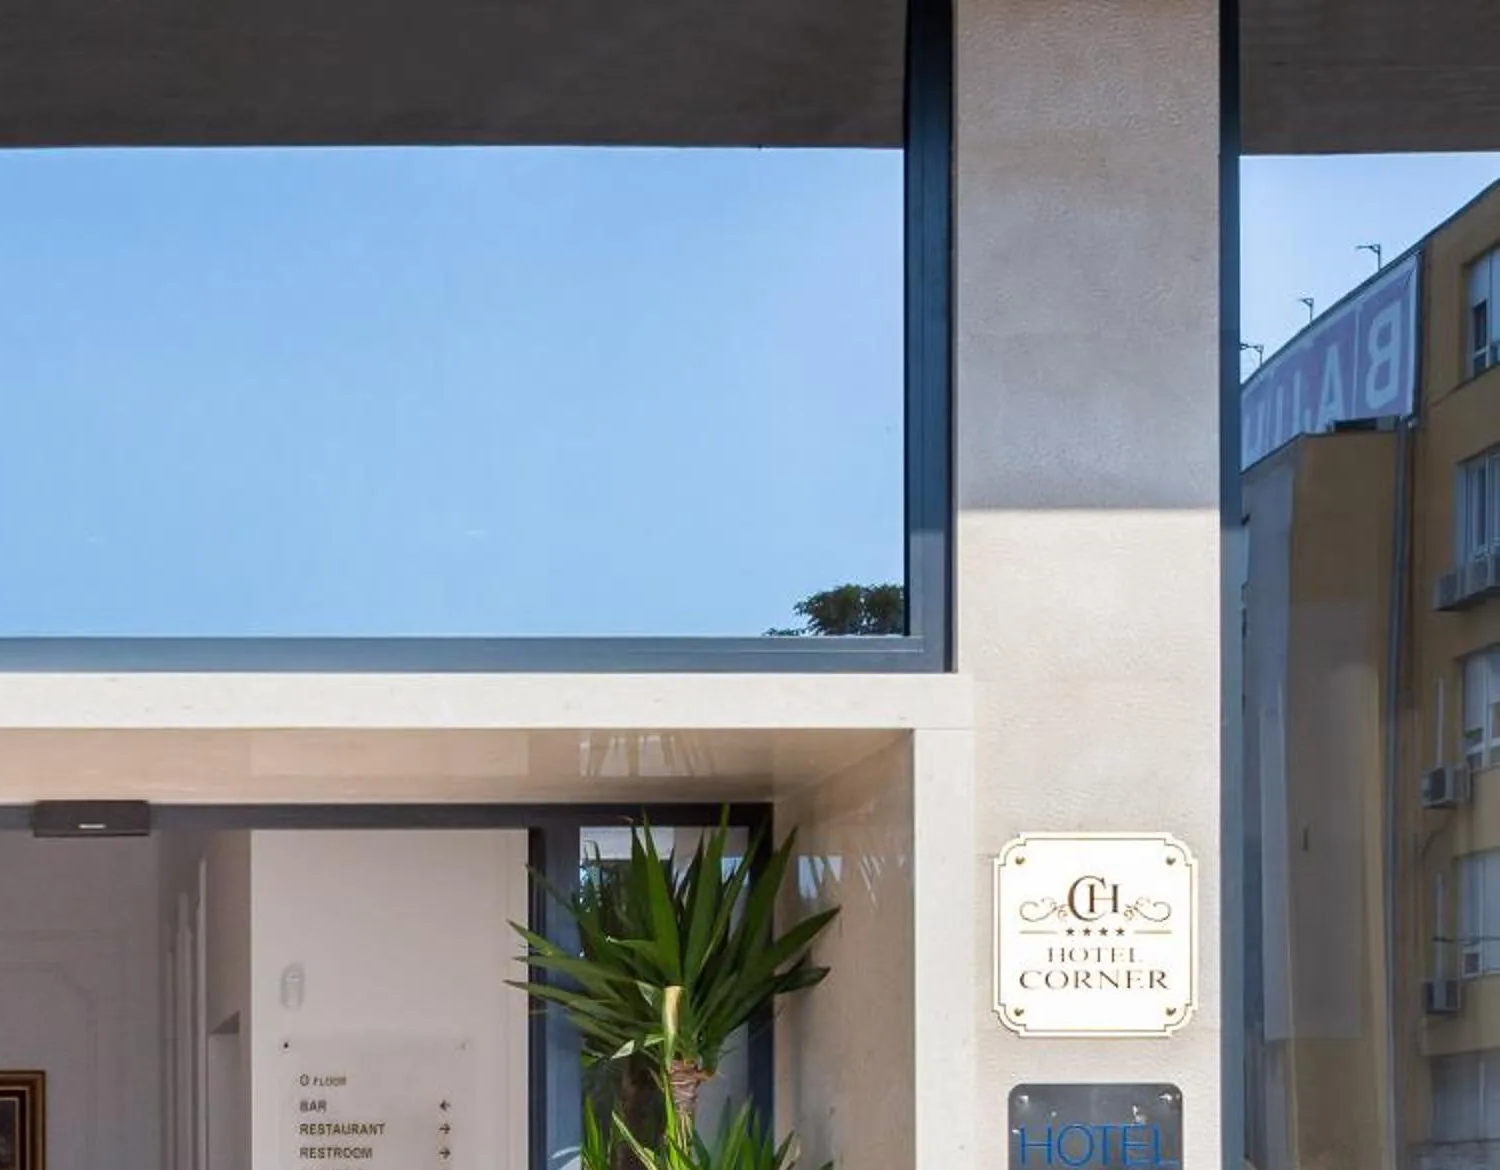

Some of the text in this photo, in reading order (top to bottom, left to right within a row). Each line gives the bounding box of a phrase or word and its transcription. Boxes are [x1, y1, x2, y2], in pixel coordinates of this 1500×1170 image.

[1047, 946, 1144, 963] HOTEL
[1019, 969, 1171, 990] CORNER
[299, 1100, 327, 1113] BAR
[299, 1122, 386, 1136] RESTAURANT
[1019, 1123, 1179, 1167] HOTEL
[299, 1147, 373, 1160] RESTROOM
